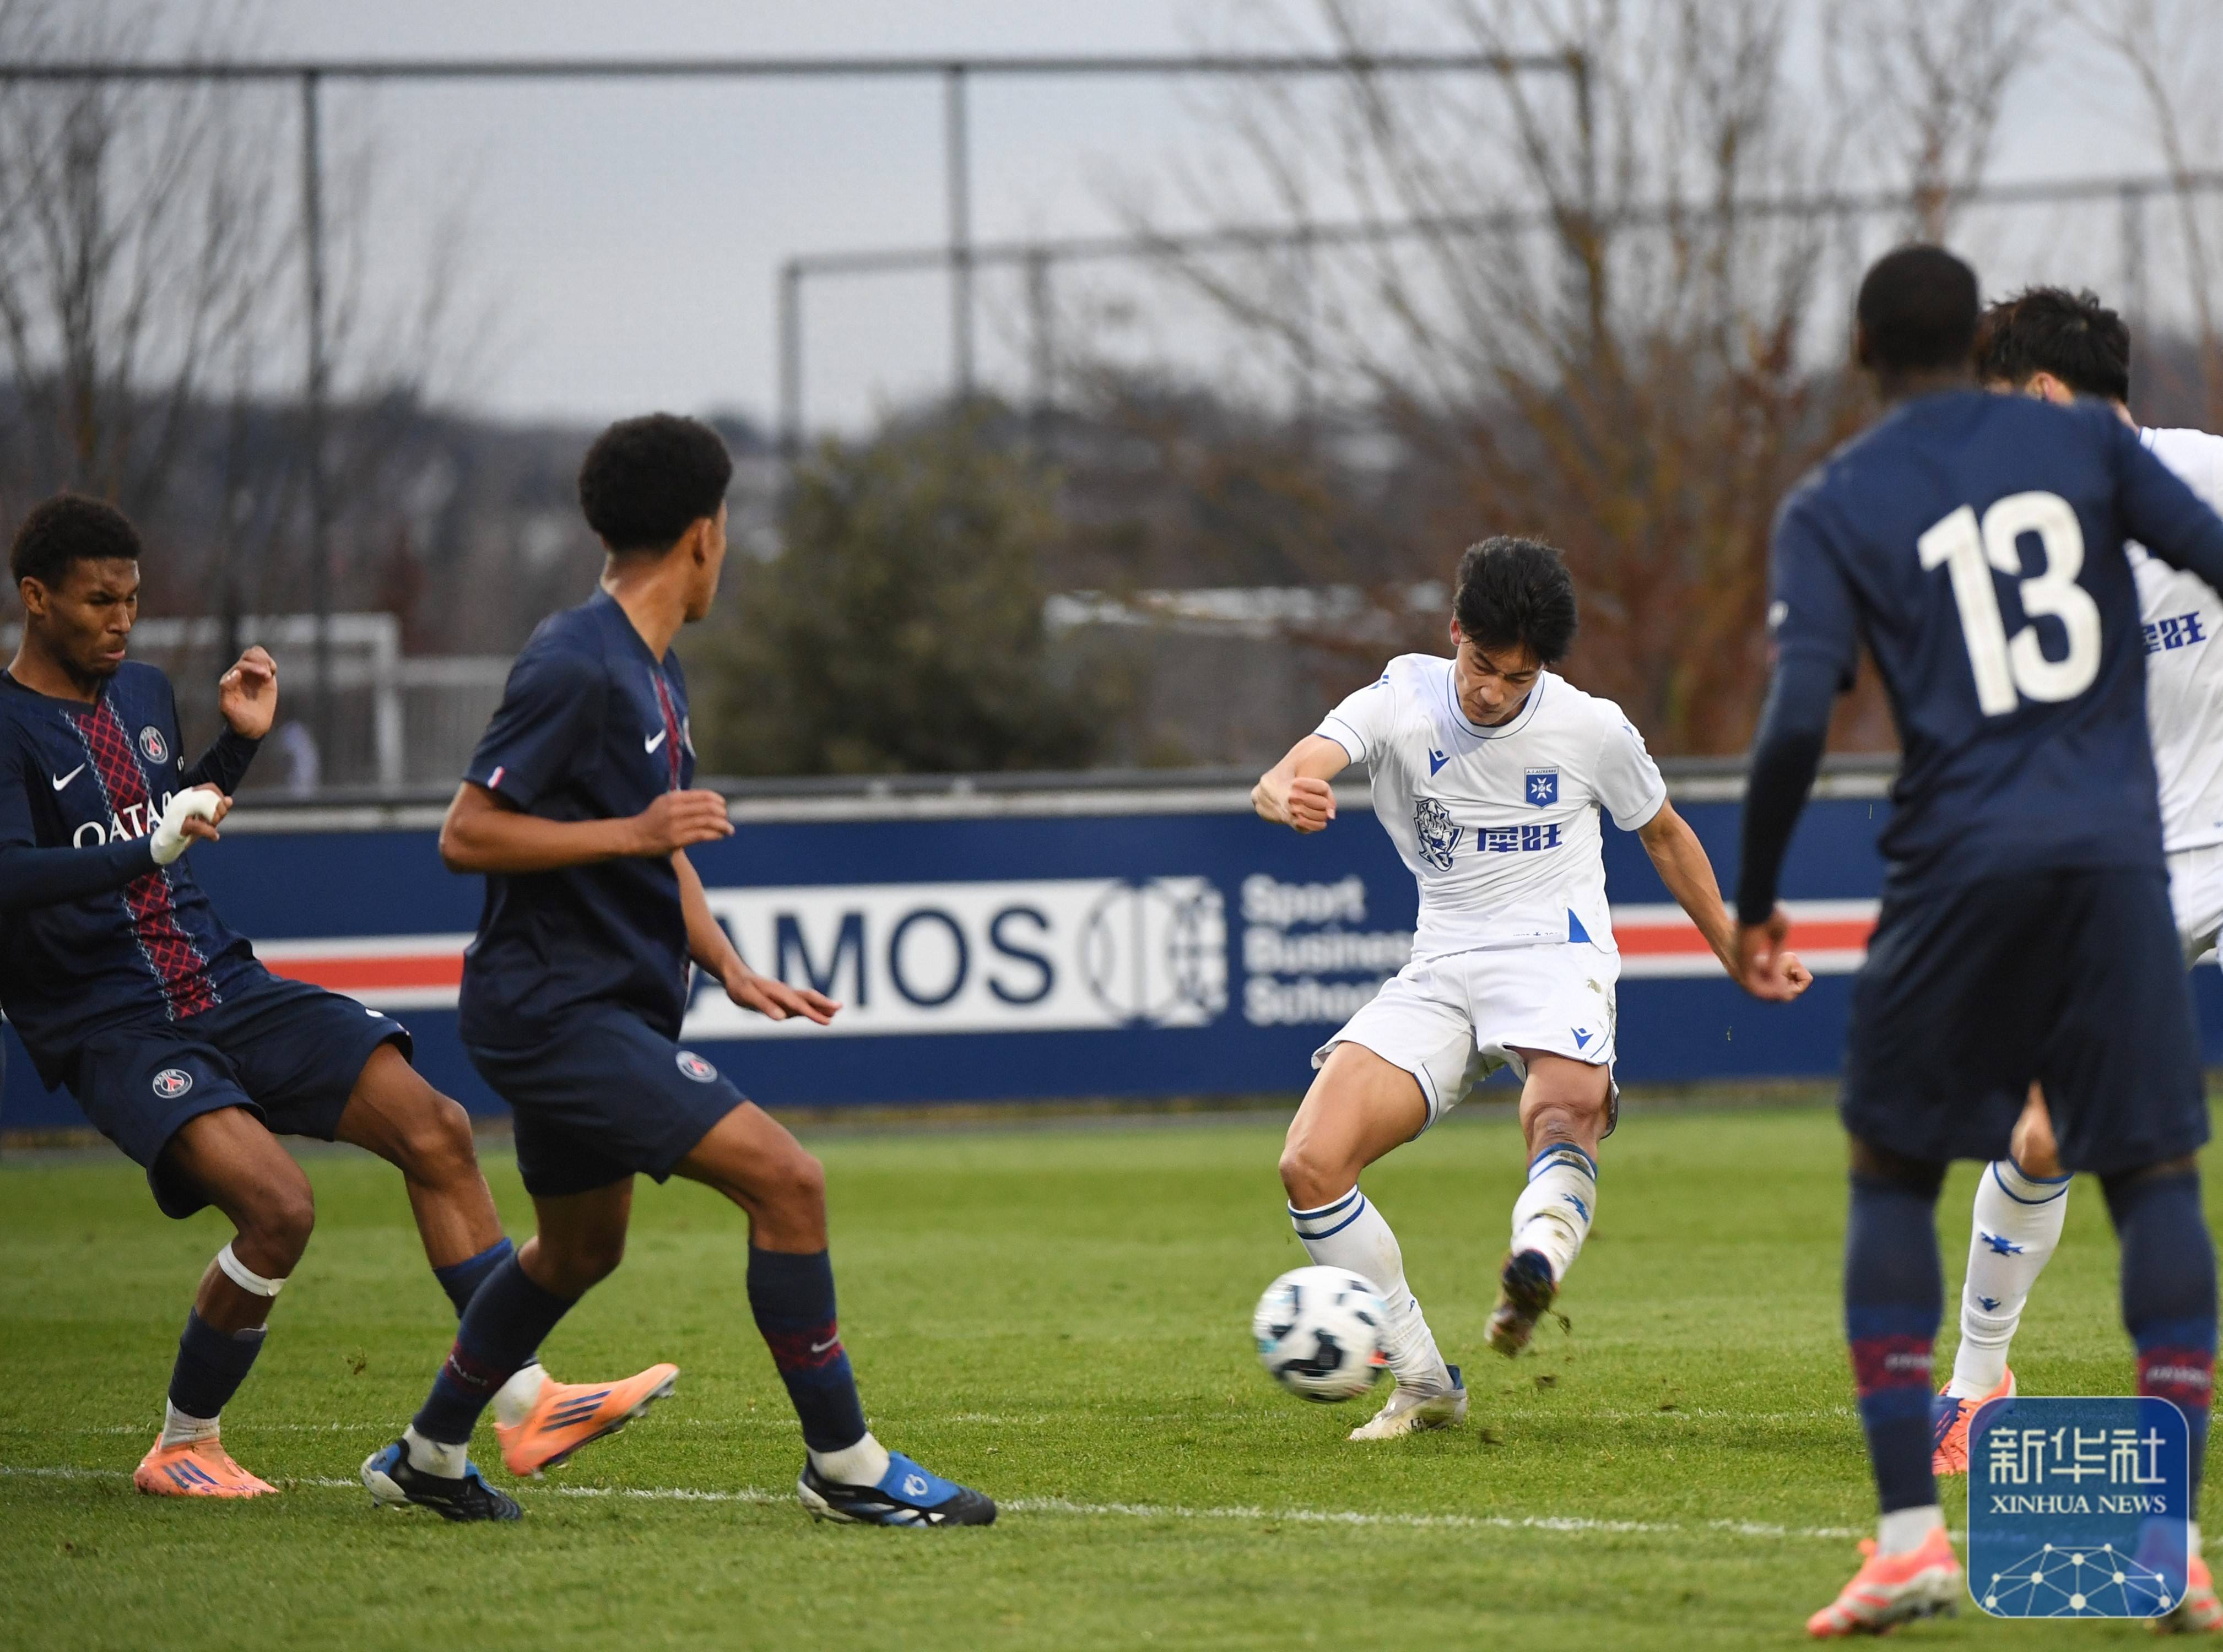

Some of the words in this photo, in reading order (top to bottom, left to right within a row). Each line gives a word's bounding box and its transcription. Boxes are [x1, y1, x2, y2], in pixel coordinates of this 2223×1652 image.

[1917, 489, 2103, 717] 13
[1242, 874, 1366, 927] Sport
[1242, 925, 1414, 972] Busines
